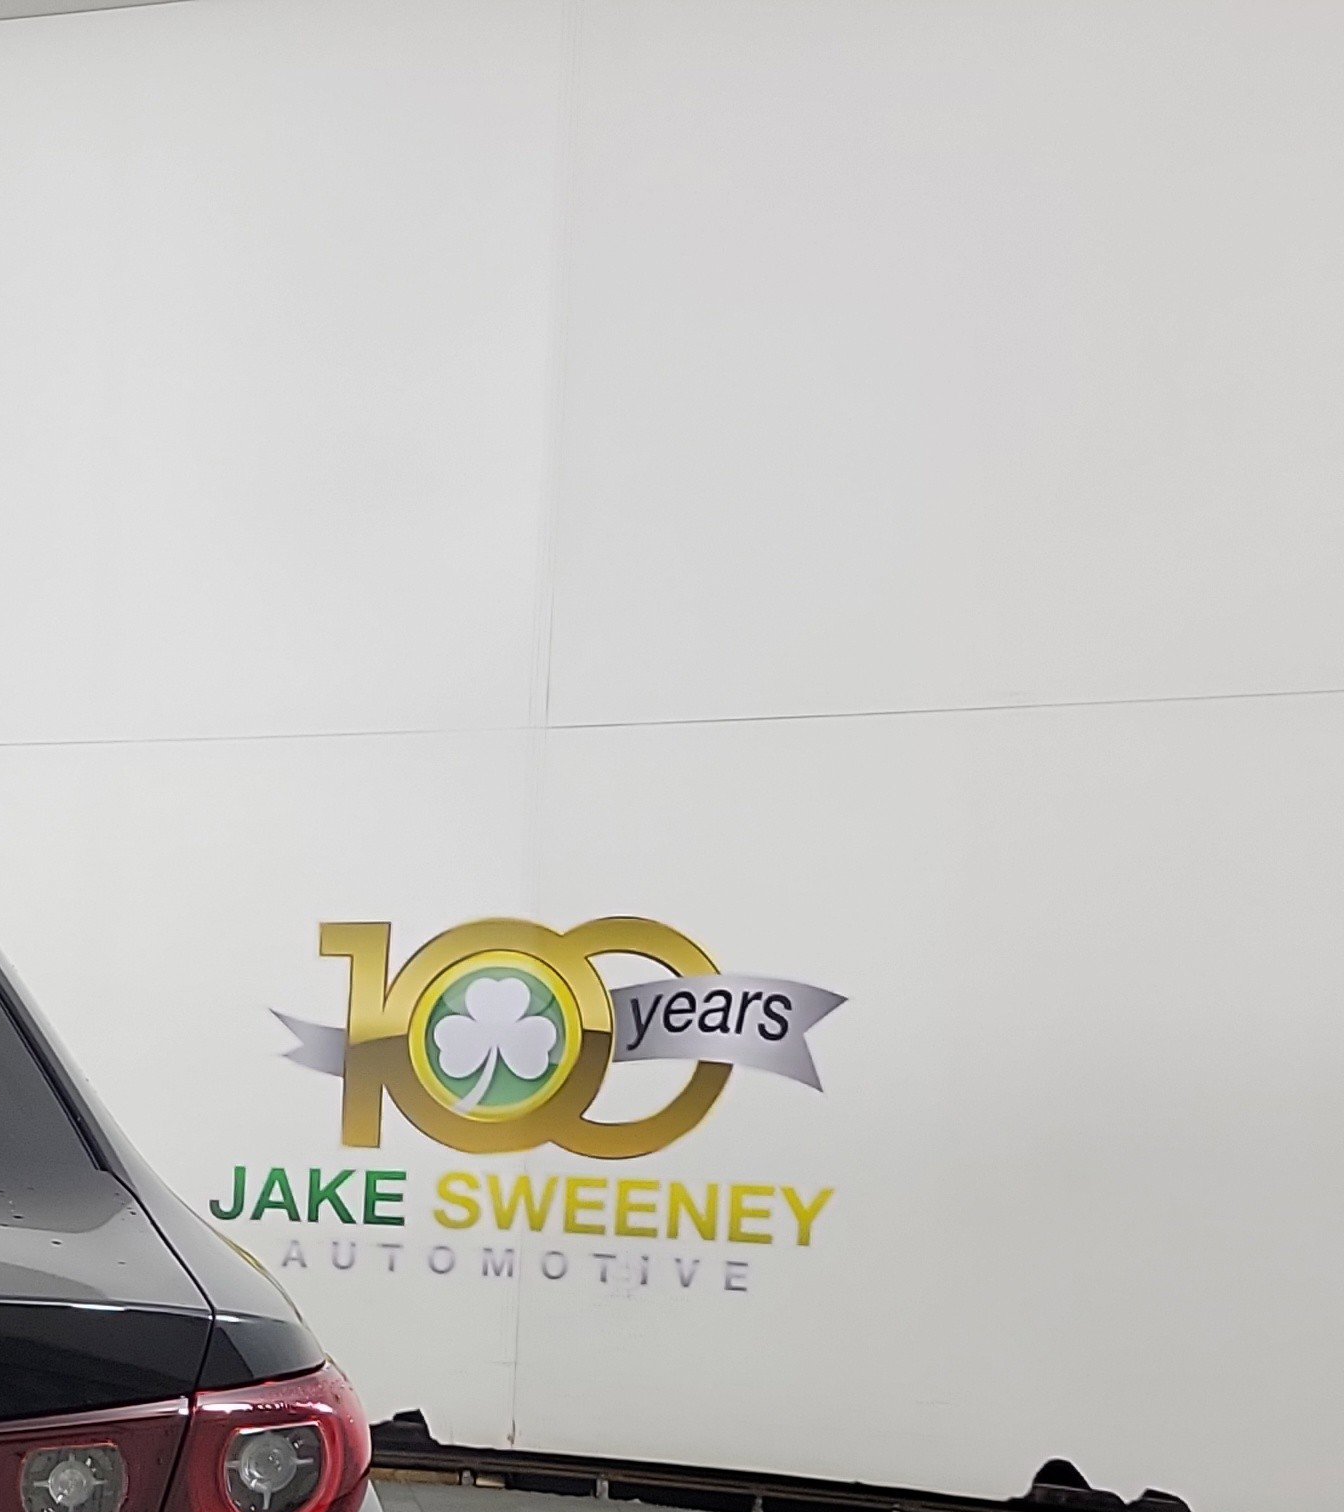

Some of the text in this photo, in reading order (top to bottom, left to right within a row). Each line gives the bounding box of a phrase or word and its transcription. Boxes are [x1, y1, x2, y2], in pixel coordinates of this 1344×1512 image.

[626, 988, 793, 1051] years
[209, 1166, 836, 1246] JAKE SWEENEY
[280, 1240, 749, 1292] AUTOMOTIVE
